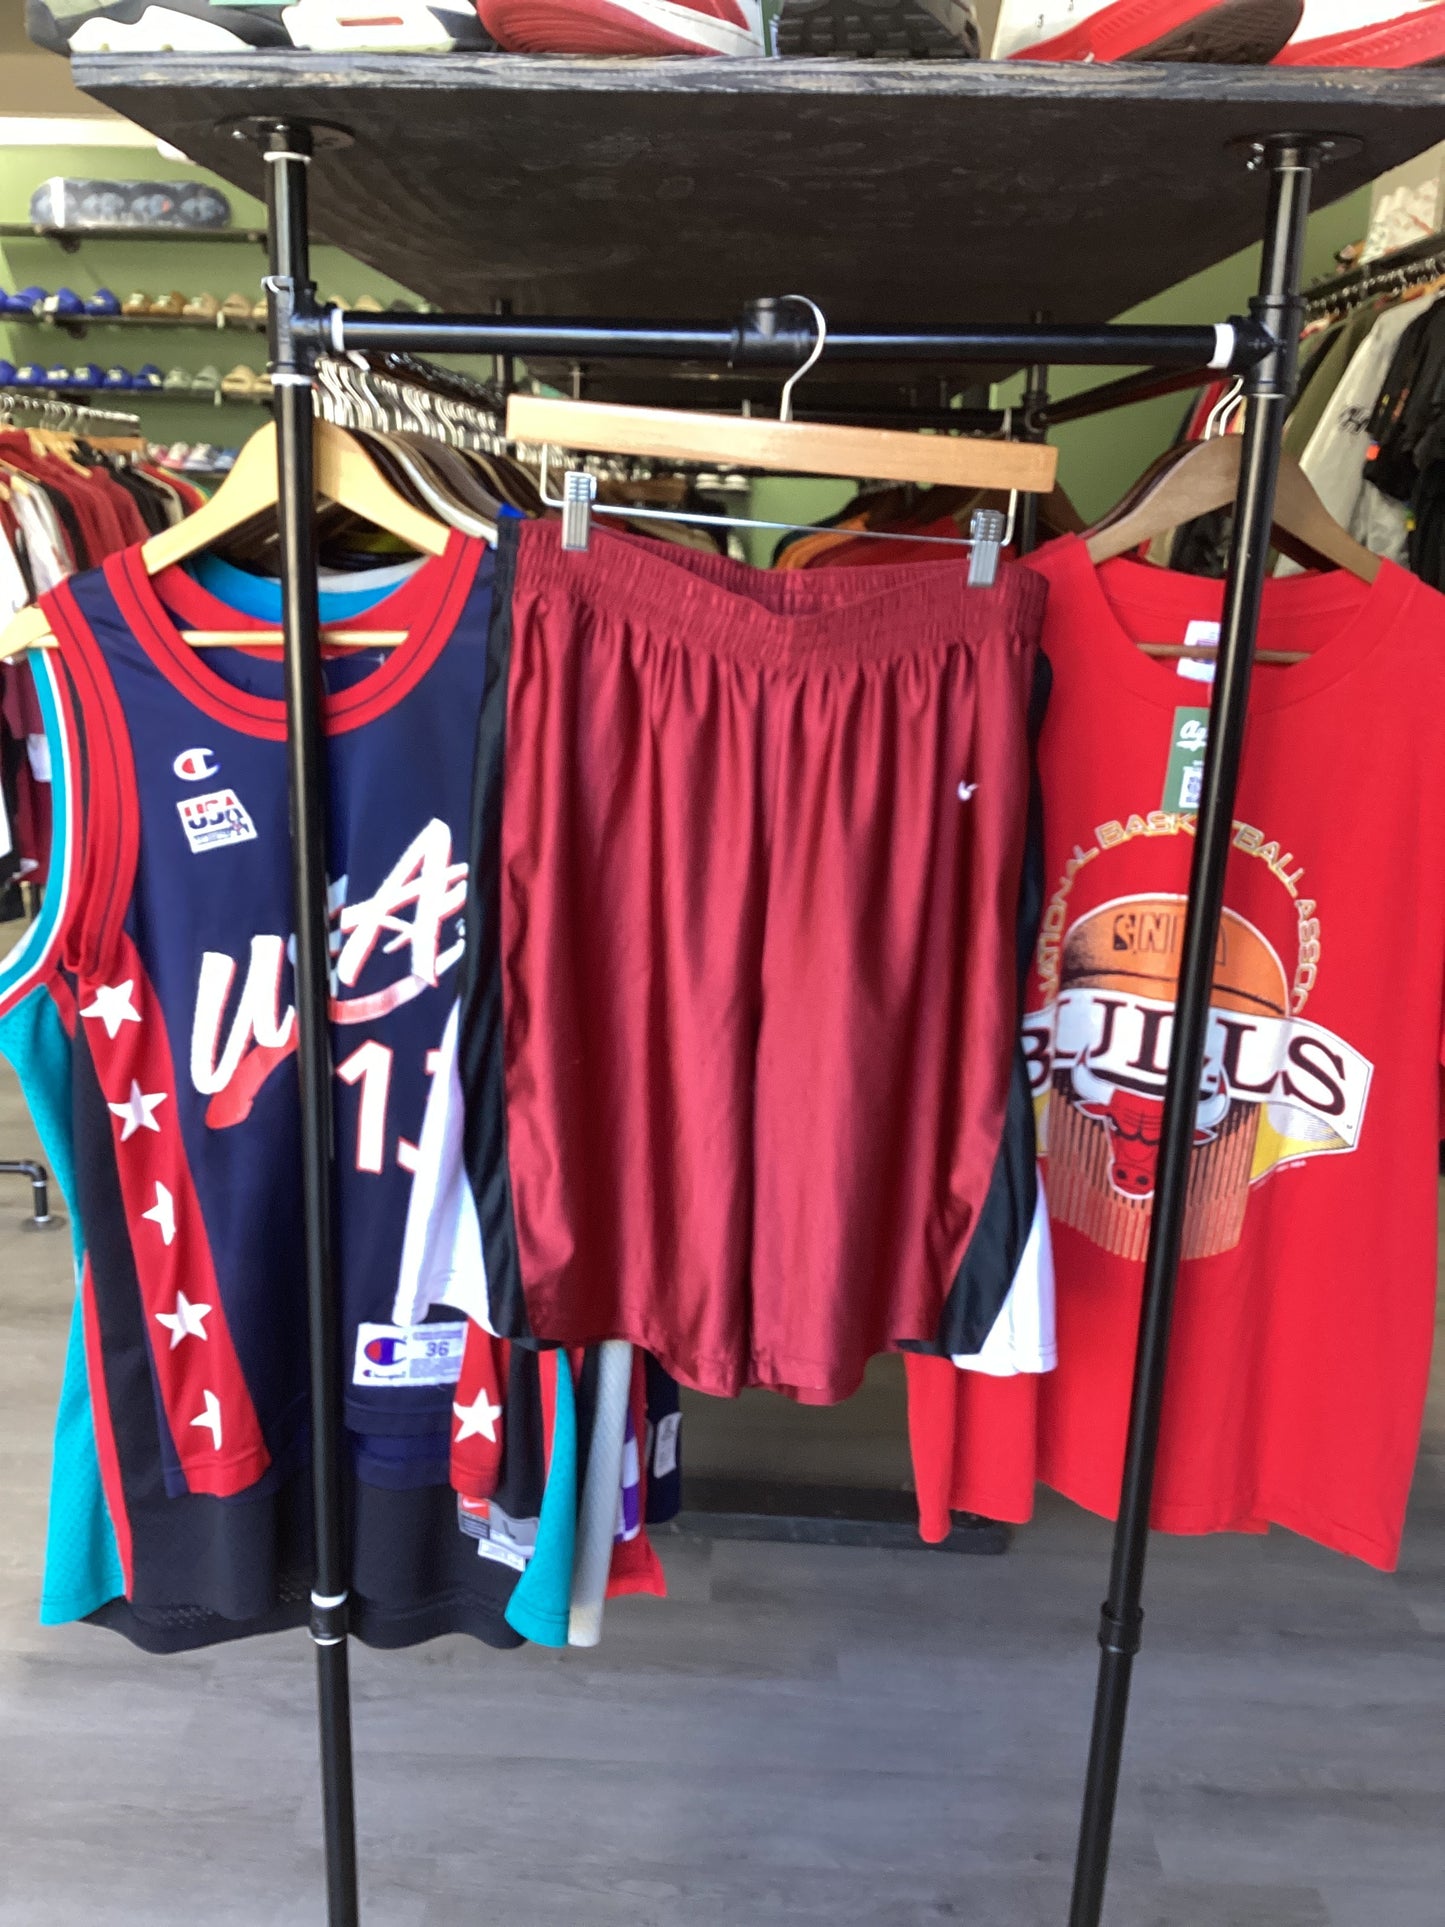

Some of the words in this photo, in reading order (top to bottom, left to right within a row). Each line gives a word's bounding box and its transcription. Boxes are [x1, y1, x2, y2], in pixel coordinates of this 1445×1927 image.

[184, 796, 245, 830] USA
[1094, 809, 1304, 899] BASKBALL
[190, 817, 469, 1096] UA
[1021, 997, 1346, 1117] BULLS
[426, 1341, 450, 1358] 36
